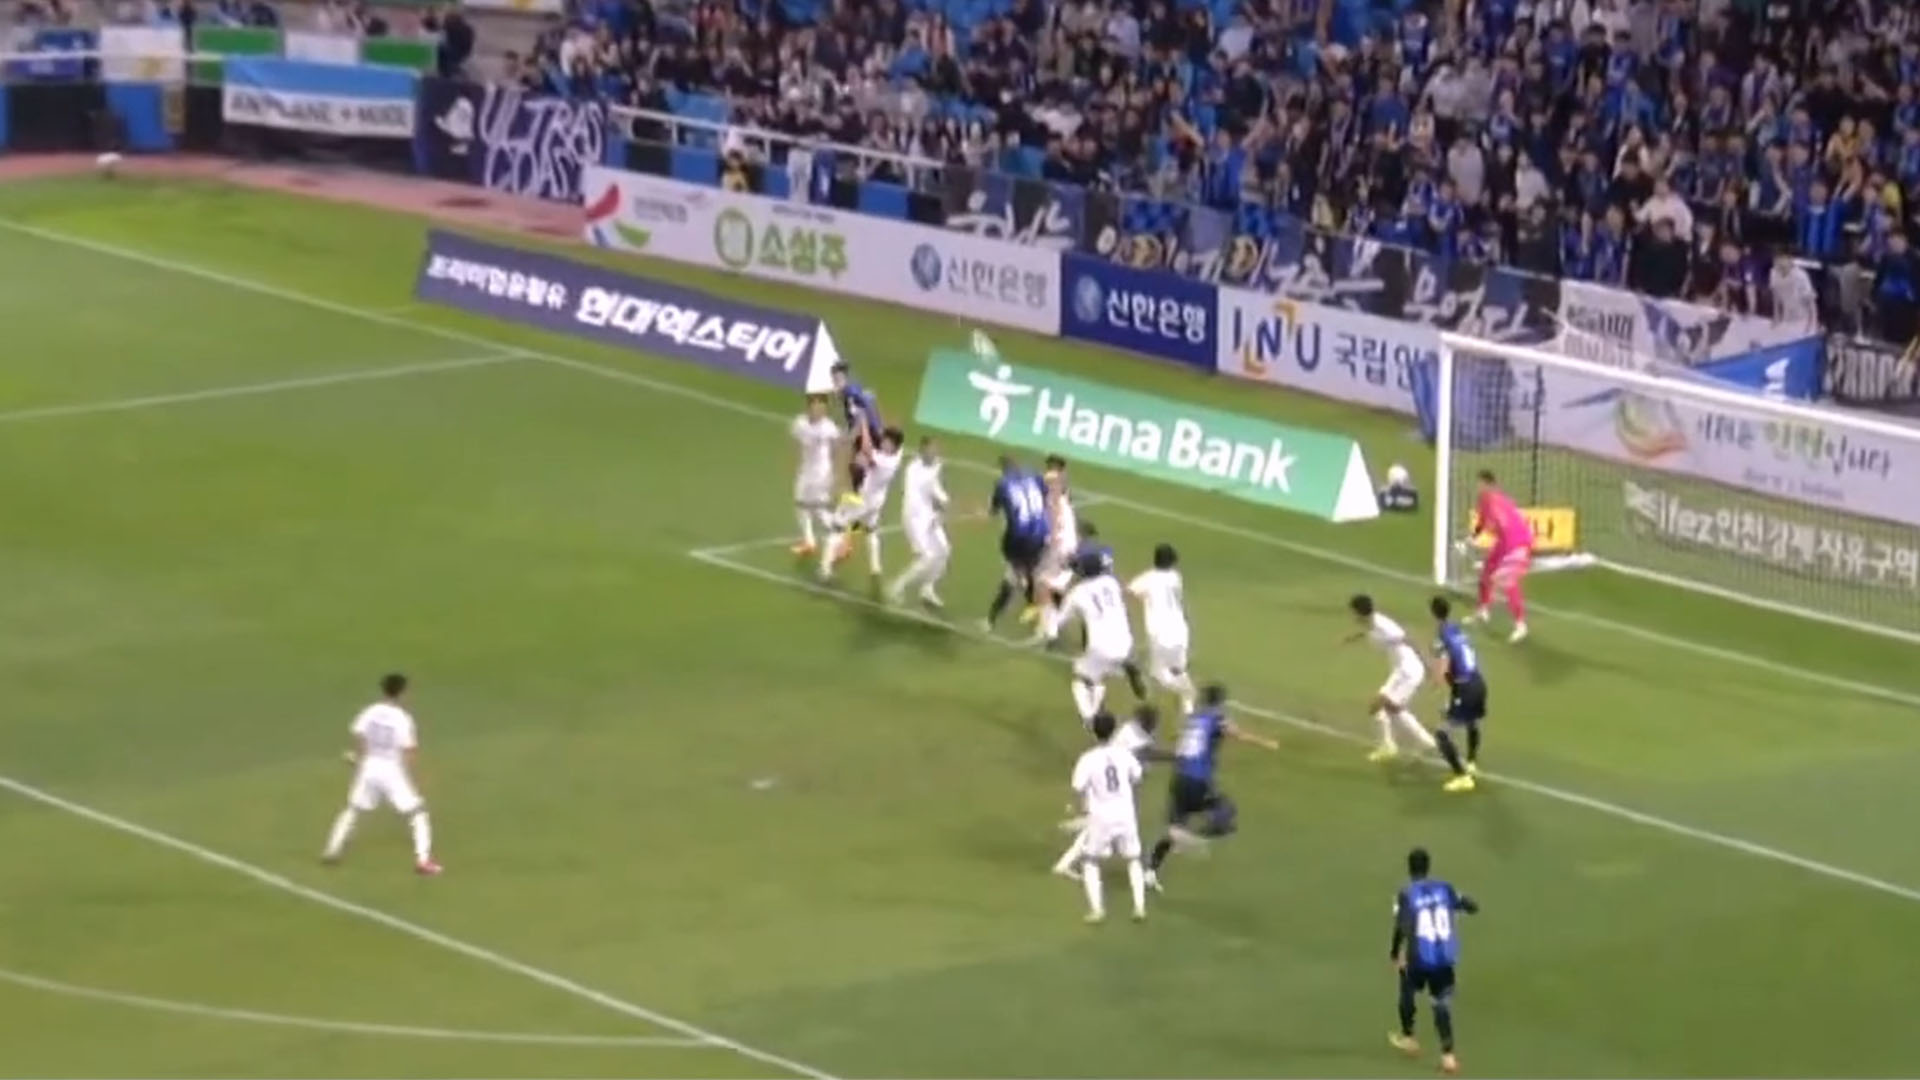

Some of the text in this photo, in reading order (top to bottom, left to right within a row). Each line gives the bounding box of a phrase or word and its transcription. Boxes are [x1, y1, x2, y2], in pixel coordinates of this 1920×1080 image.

[480, 80, 603, 166] ULTRAS
[759, 224, 847, 278] 소성주
[947, 254, 1047, 308] 신한은행
[576, 287, 808, 371] 현대엑스티어
[1107, 289, 1206, 342] 신한은행
[1233, 307, 1322, 373] INU
[1033, 388, 1296, 493] Hana Bank
[1105, 765, 1120, 793] 8
[1418, 904, 1450, 942] 40
